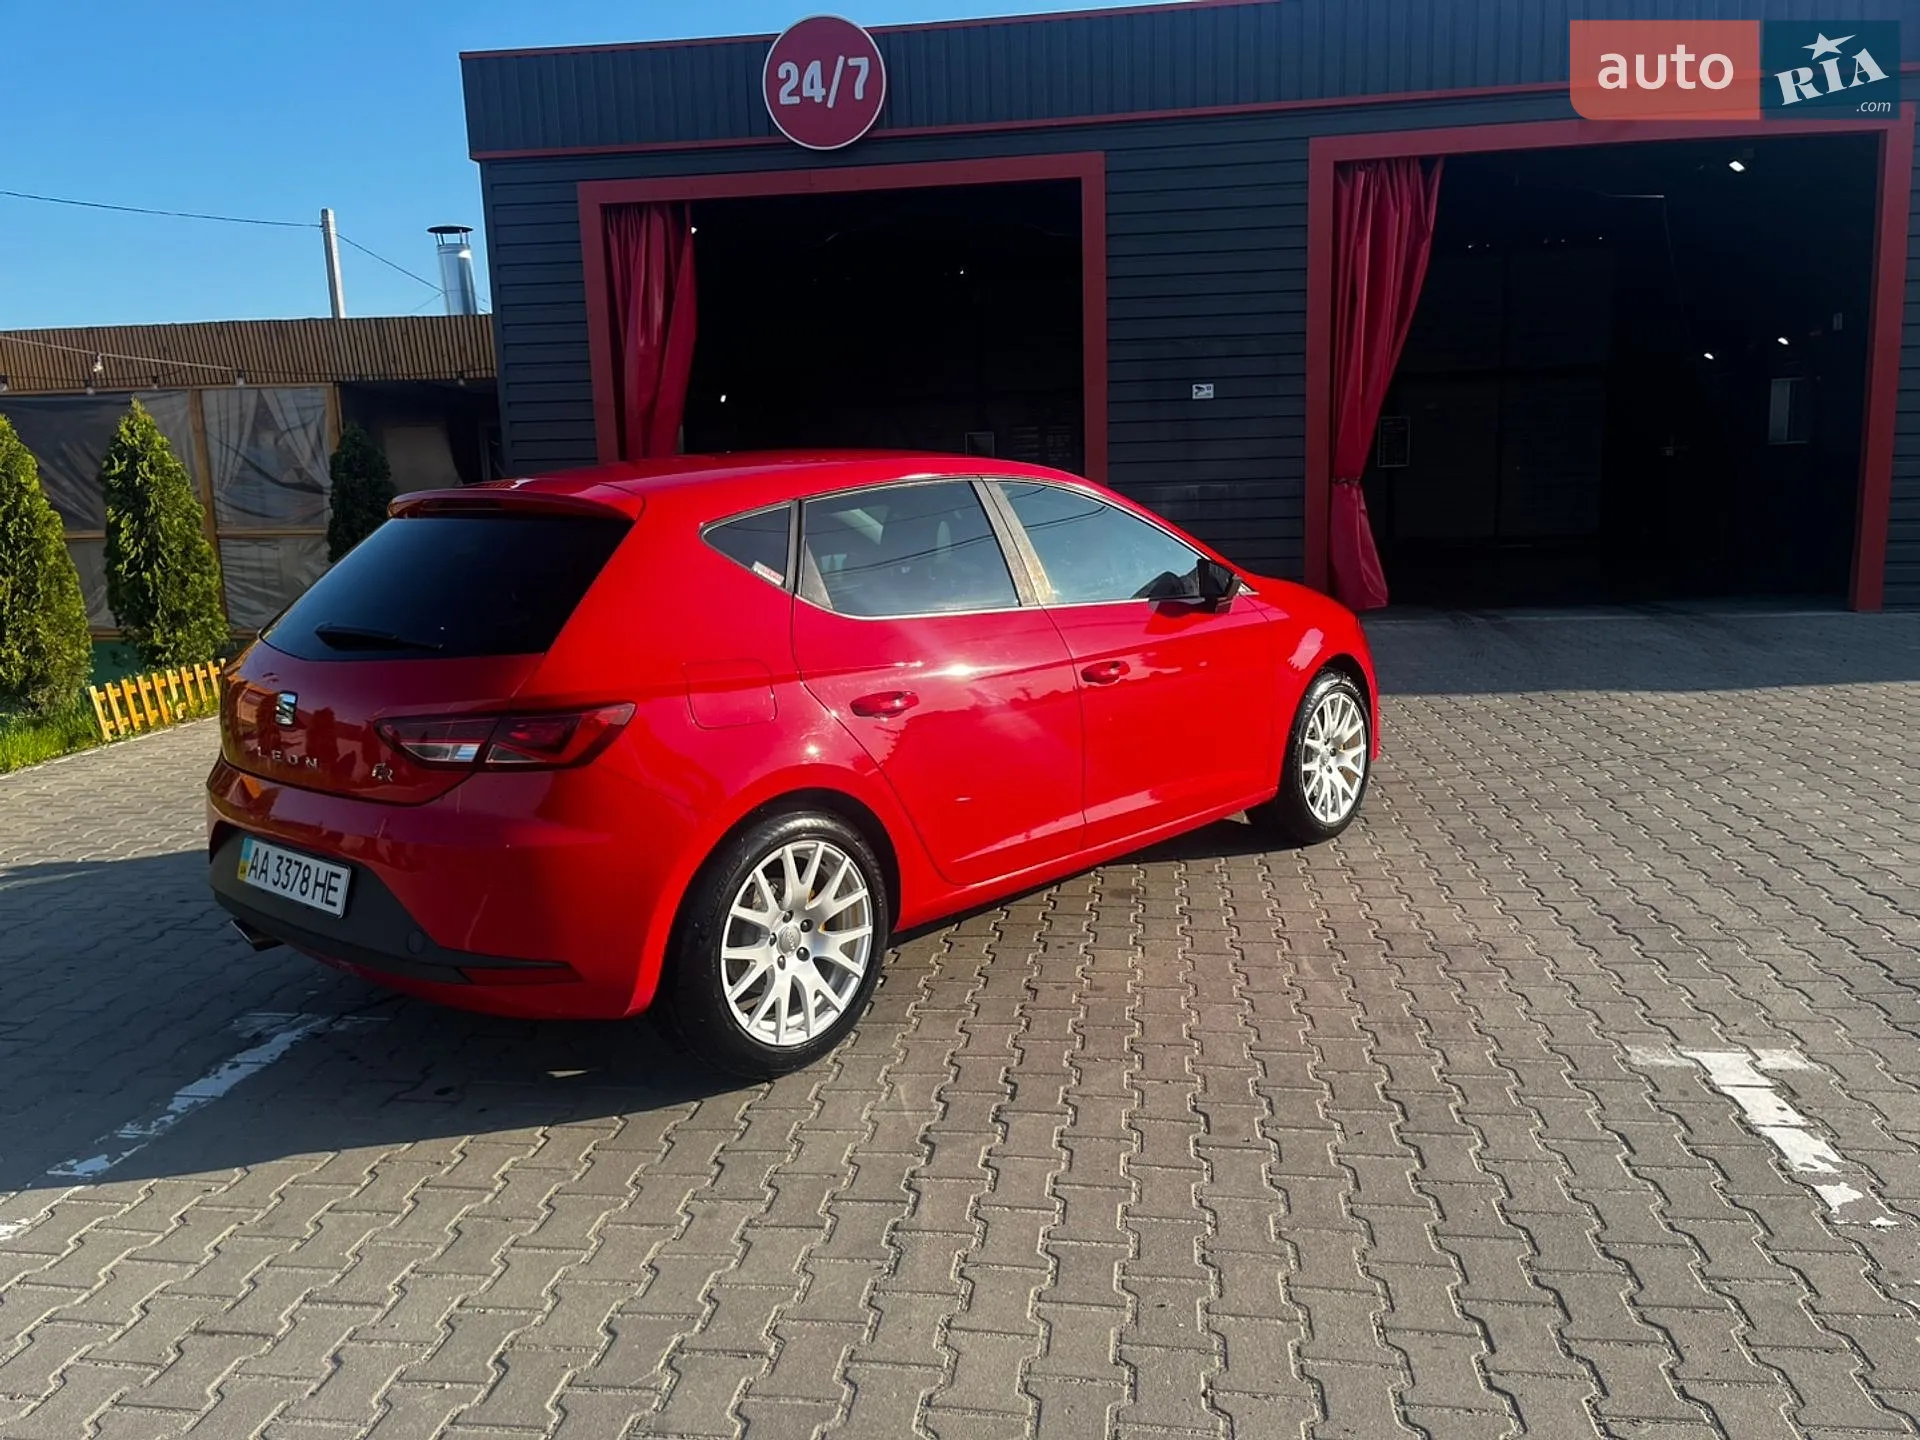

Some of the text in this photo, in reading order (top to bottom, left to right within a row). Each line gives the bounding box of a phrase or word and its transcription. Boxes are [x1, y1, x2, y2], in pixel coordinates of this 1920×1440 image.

[778, 55, 869, 108] 24/7
[257, 746, 318, 769] LEON
[247, 847, 342, 908] AA 3378 HE
